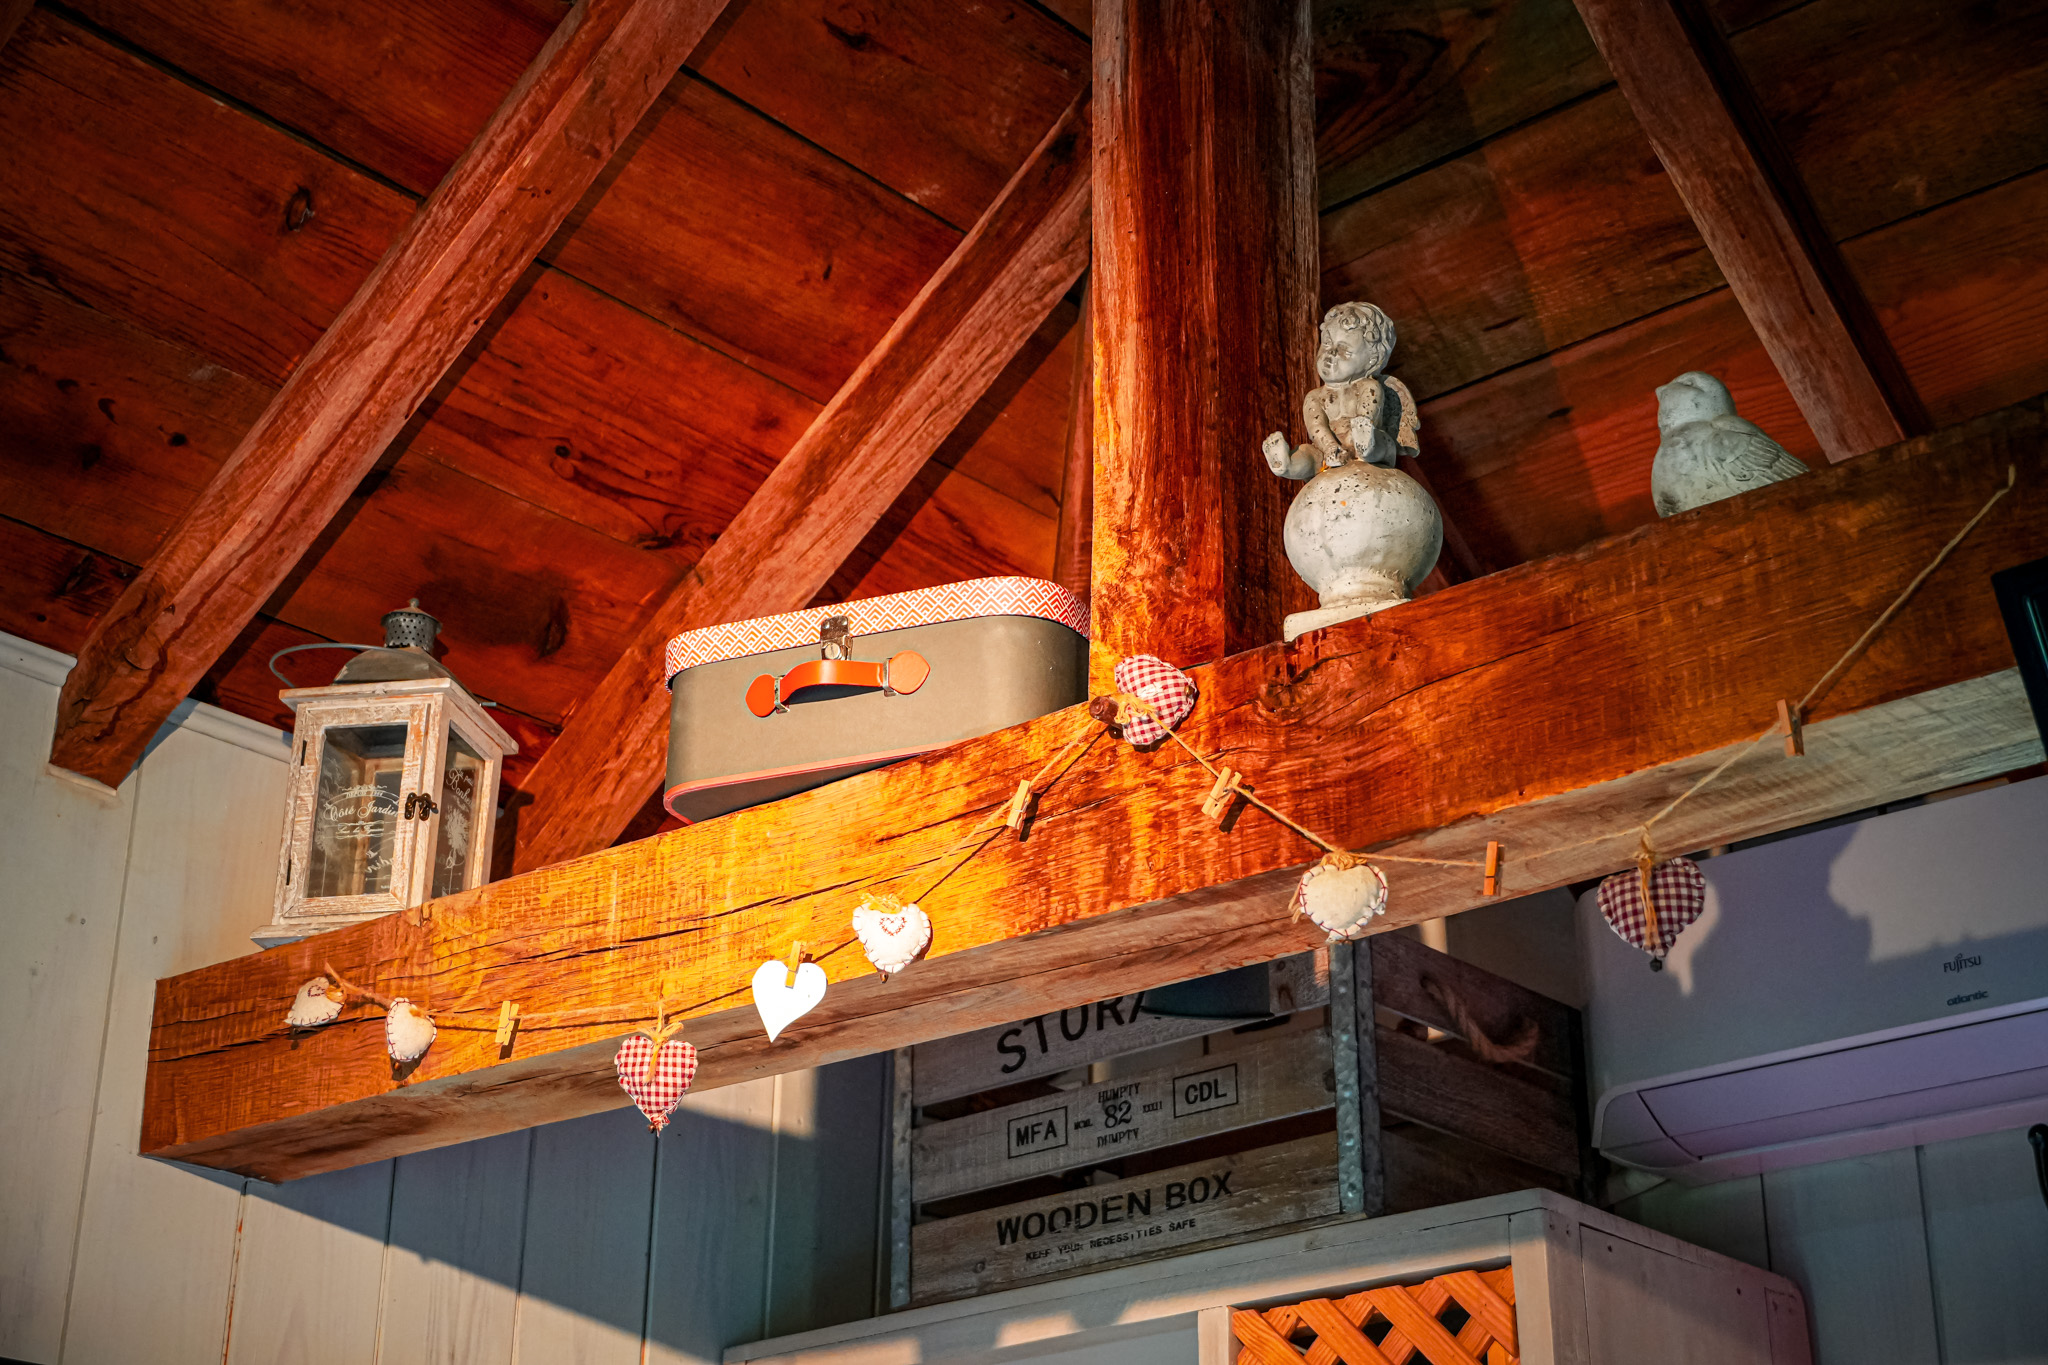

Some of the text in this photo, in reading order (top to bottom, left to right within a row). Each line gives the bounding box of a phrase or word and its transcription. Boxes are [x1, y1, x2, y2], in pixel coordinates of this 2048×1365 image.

[323, 805, 357, 822] Côté
[1943, 953, 1982, 973] FUJITSU
[1947, 990, 1989, 1006] atlantic
[1098, 1082, 1141, 1104] HUMPTY
[1184, 1080, 1228, 1105] CDL
[1104, 1100, 1132, 1129] 82
[1016, 1119, 1058, 1147] MFA
[996, 1171, 1233, 1246] WOODEN BOX
[1168, 1218, 1197, 1234] SAFE
